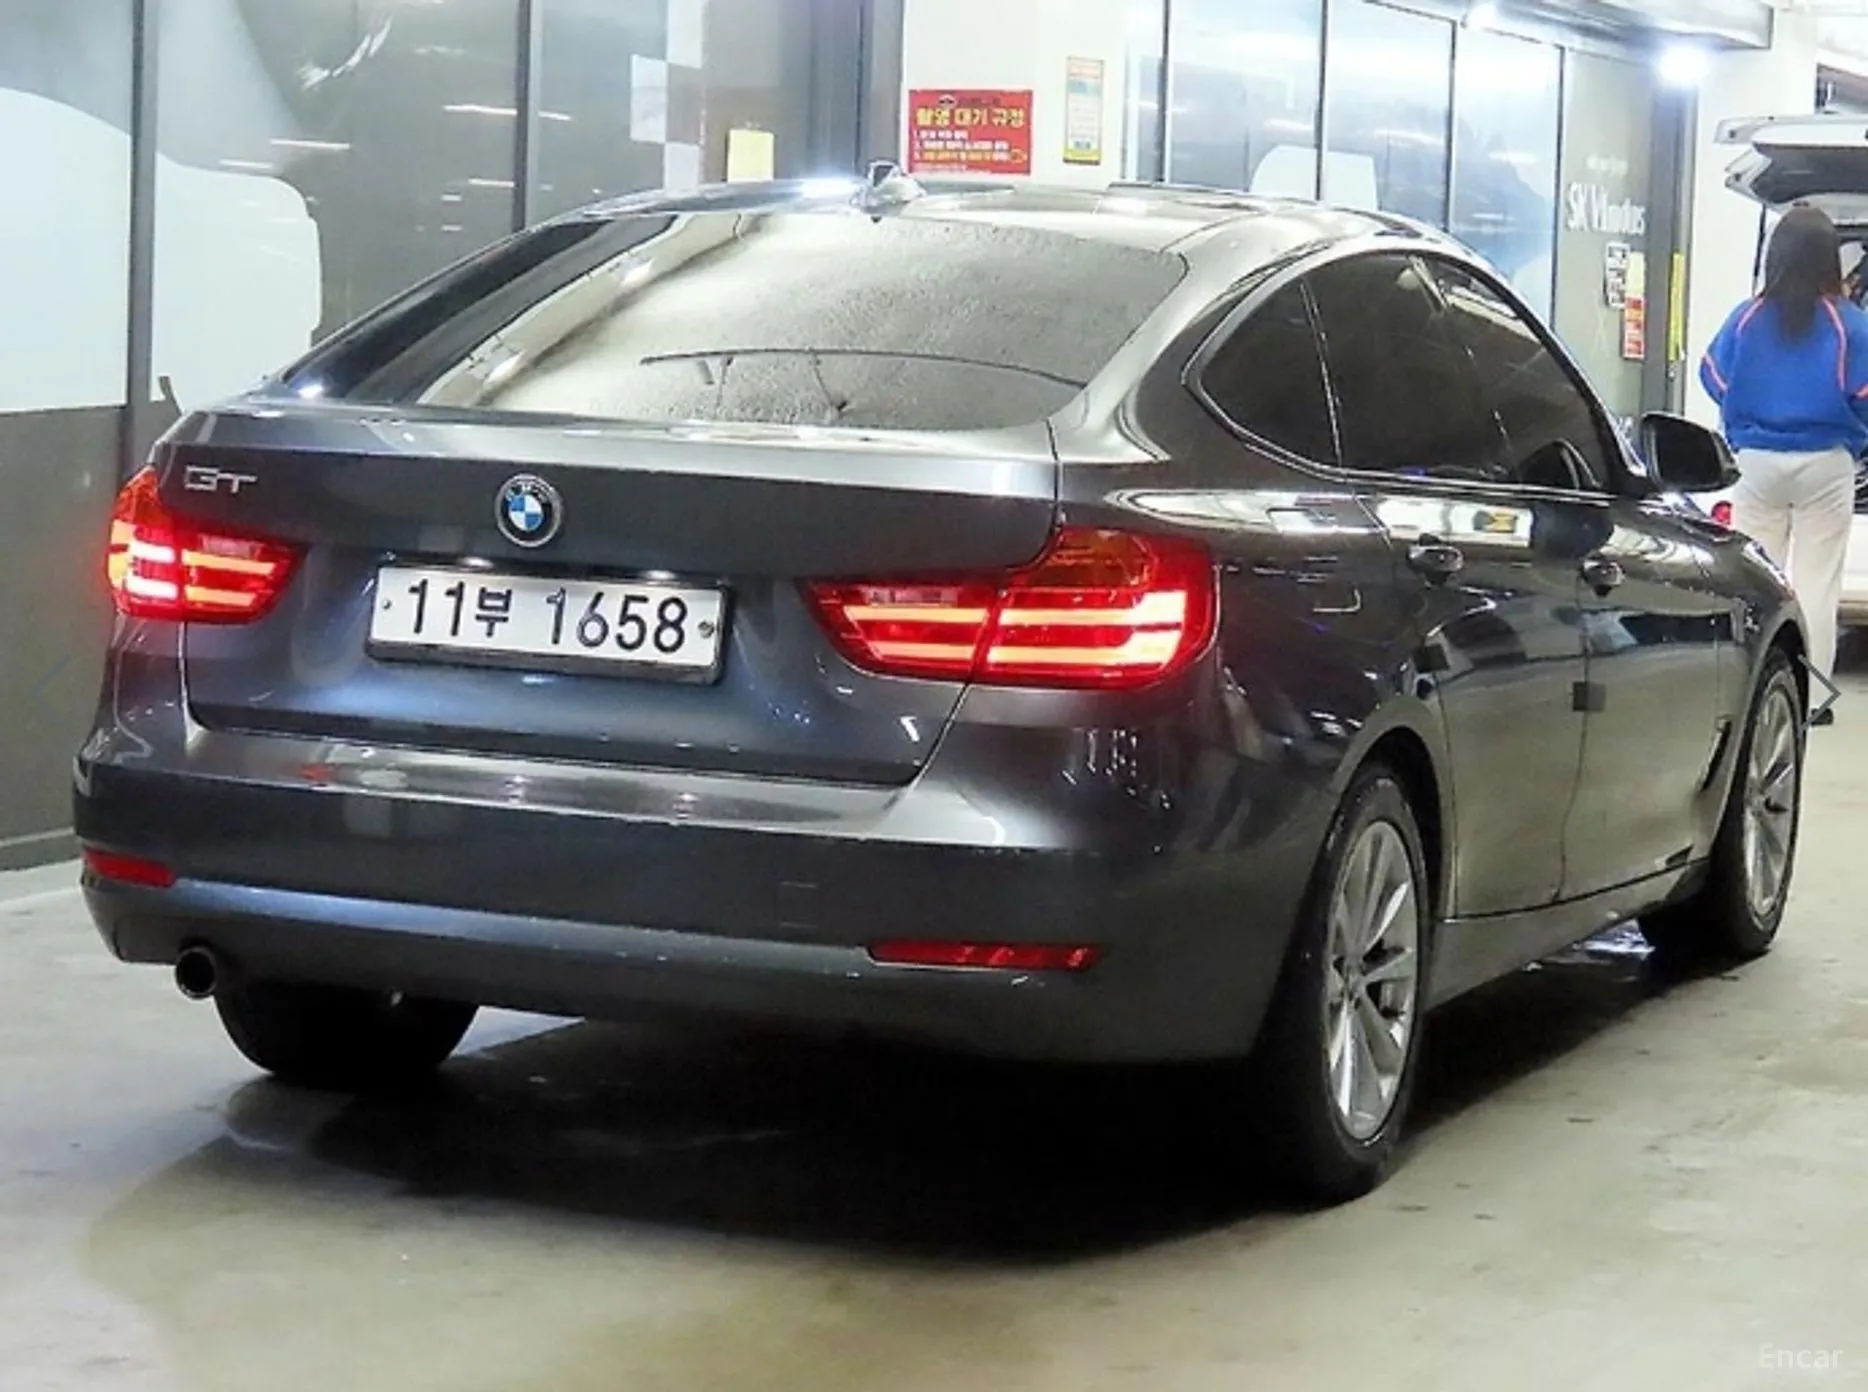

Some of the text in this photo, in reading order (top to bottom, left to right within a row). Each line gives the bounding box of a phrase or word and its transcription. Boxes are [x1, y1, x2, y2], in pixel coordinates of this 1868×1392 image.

[954, 107, 988, 126] 대기
[184, 465, 258, 493] GT
[408, 578, 688, 654] 11부 1658
